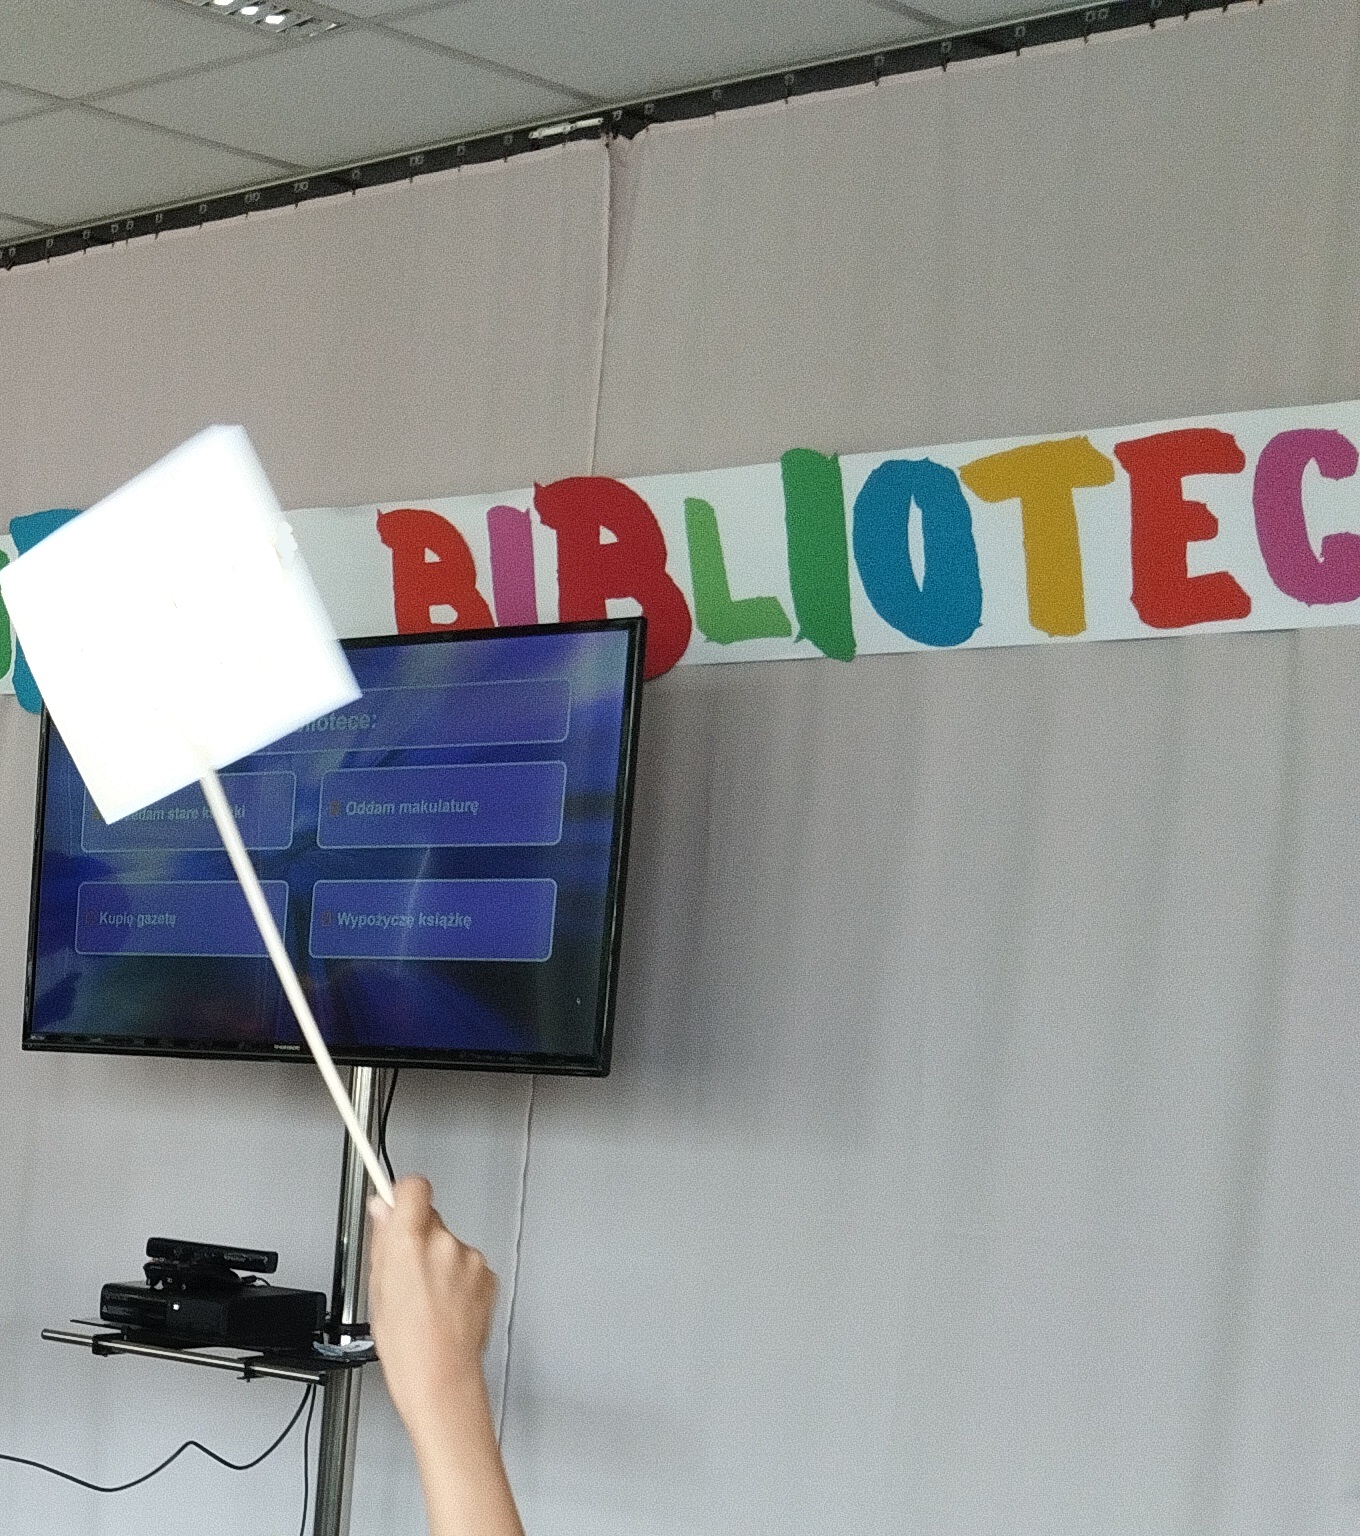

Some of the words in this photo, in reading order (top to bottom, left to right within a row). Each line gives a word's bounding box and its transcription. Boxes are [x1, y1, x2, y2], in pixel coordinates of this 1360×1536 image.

[374, 426, 1359, 679] BIBLIOTEC
[345, 800, 395, 815] Oddam
[399, 799, 479, 816] makulaturę
[418, 911, 472, 930] książkę
